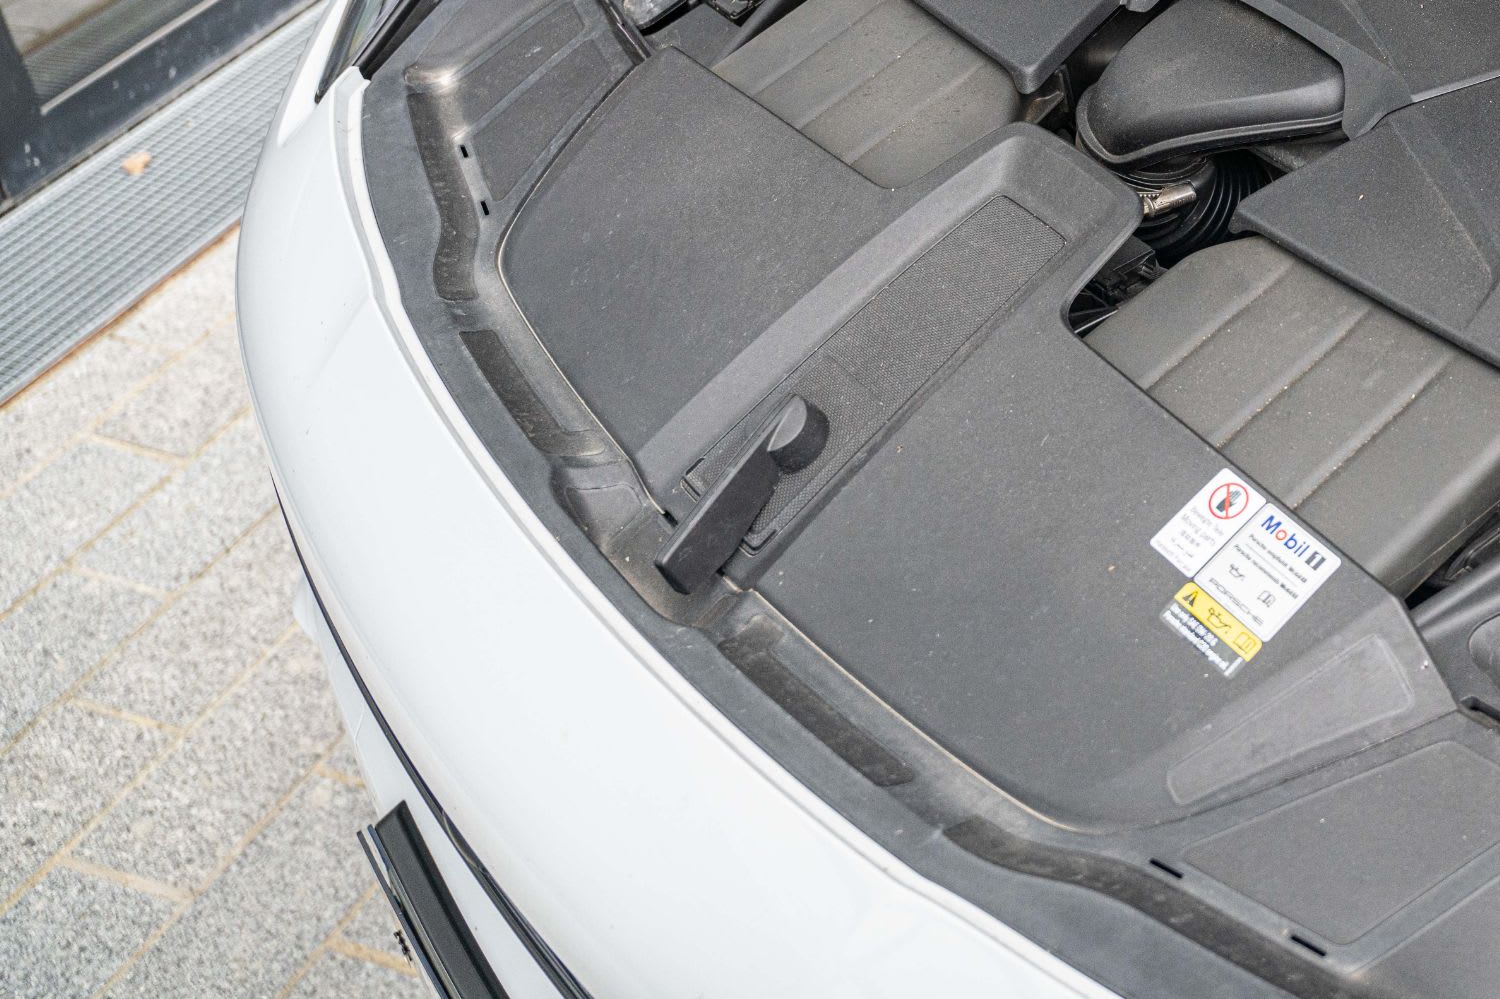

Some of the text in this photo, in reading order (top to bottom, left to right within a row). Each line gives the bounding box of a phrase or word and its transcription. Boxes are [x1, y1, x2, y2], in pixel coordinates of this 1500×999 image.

[1260, 514, 1327, 571] Mobil 1
[1208, 577, 1264, 626] PORSCHE
